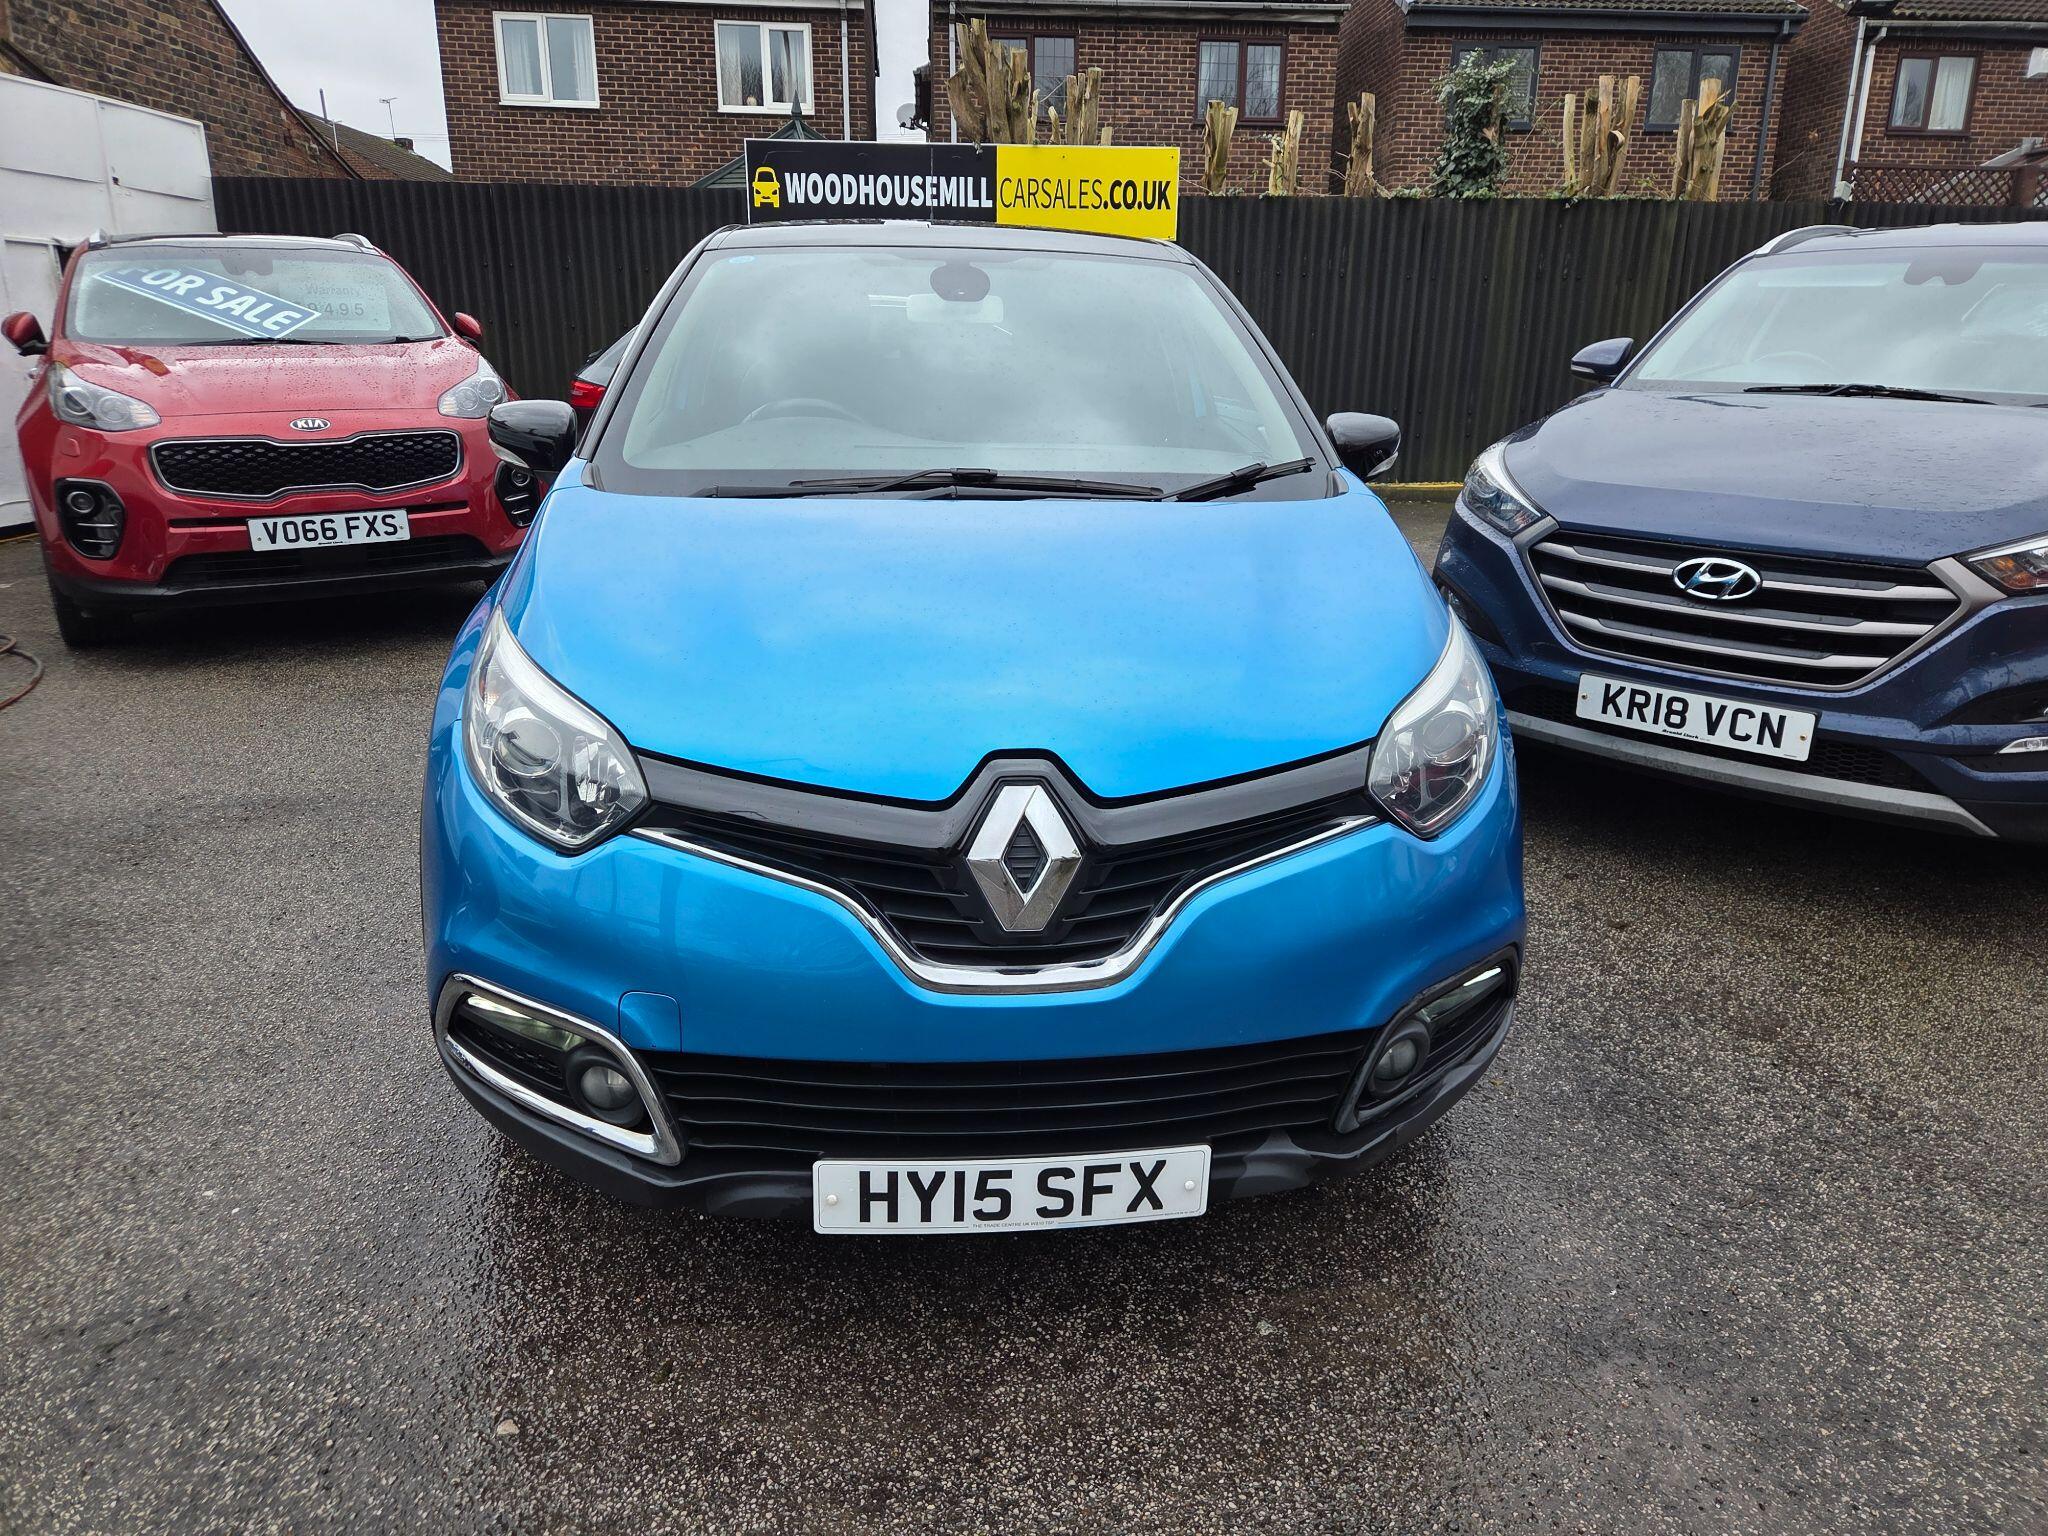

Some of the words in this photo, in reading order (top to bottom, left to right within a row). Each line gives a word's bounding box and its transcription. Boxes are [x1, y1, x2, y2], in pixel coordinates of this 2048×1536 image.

[784, 172, 993, 208] WOODHOUSEMILL
[1000, 176, 1171, 210] CARSALES.CO.UK
[195, 286, 303, 331] SALE
[296, 419, 325, 428] KIA
[345, 514, 399, 539] FXS
[1601, 683, 1689, 730] KR18
[1705, 702, 1787, 749] VCN
[858, 1169, 1013, 1223] HY15
[1035, 1159, 1168, 1219] SFX
